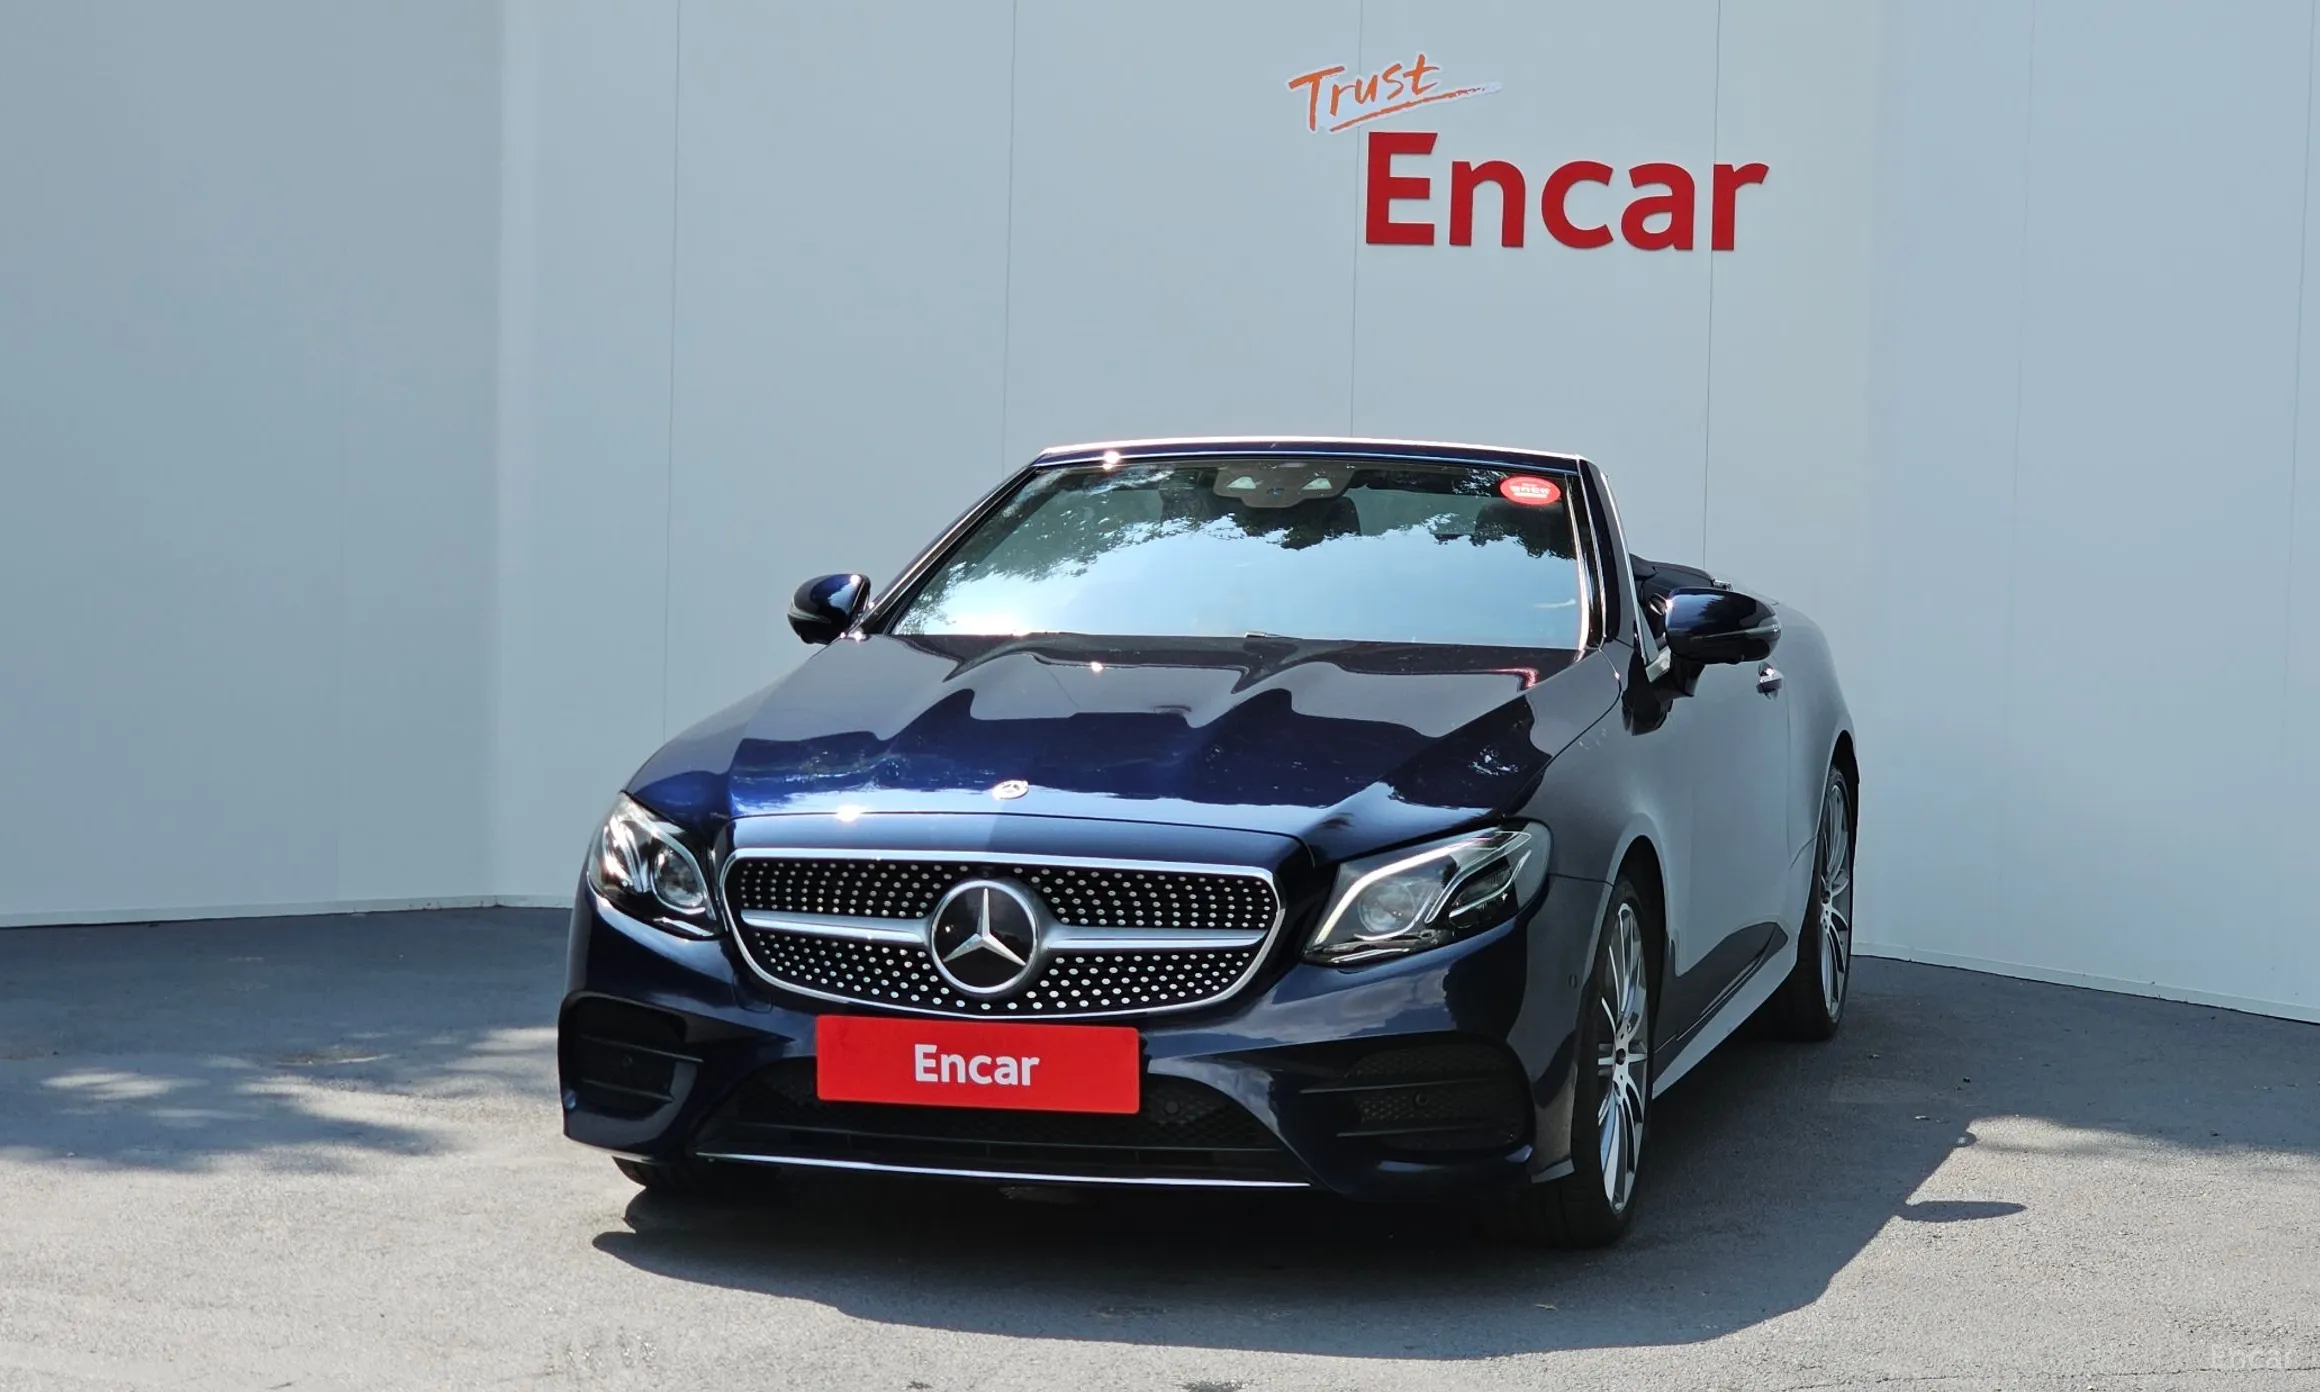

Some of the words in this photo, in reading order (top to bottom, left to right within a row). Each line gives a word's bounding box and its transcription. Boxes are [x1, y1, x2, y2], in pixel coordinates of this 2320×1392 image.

[1288, 53, 1440, 132] Trust
[1365, 131, 1770, 251] Encar
[914, 1043, 1040, 1086] Encar
